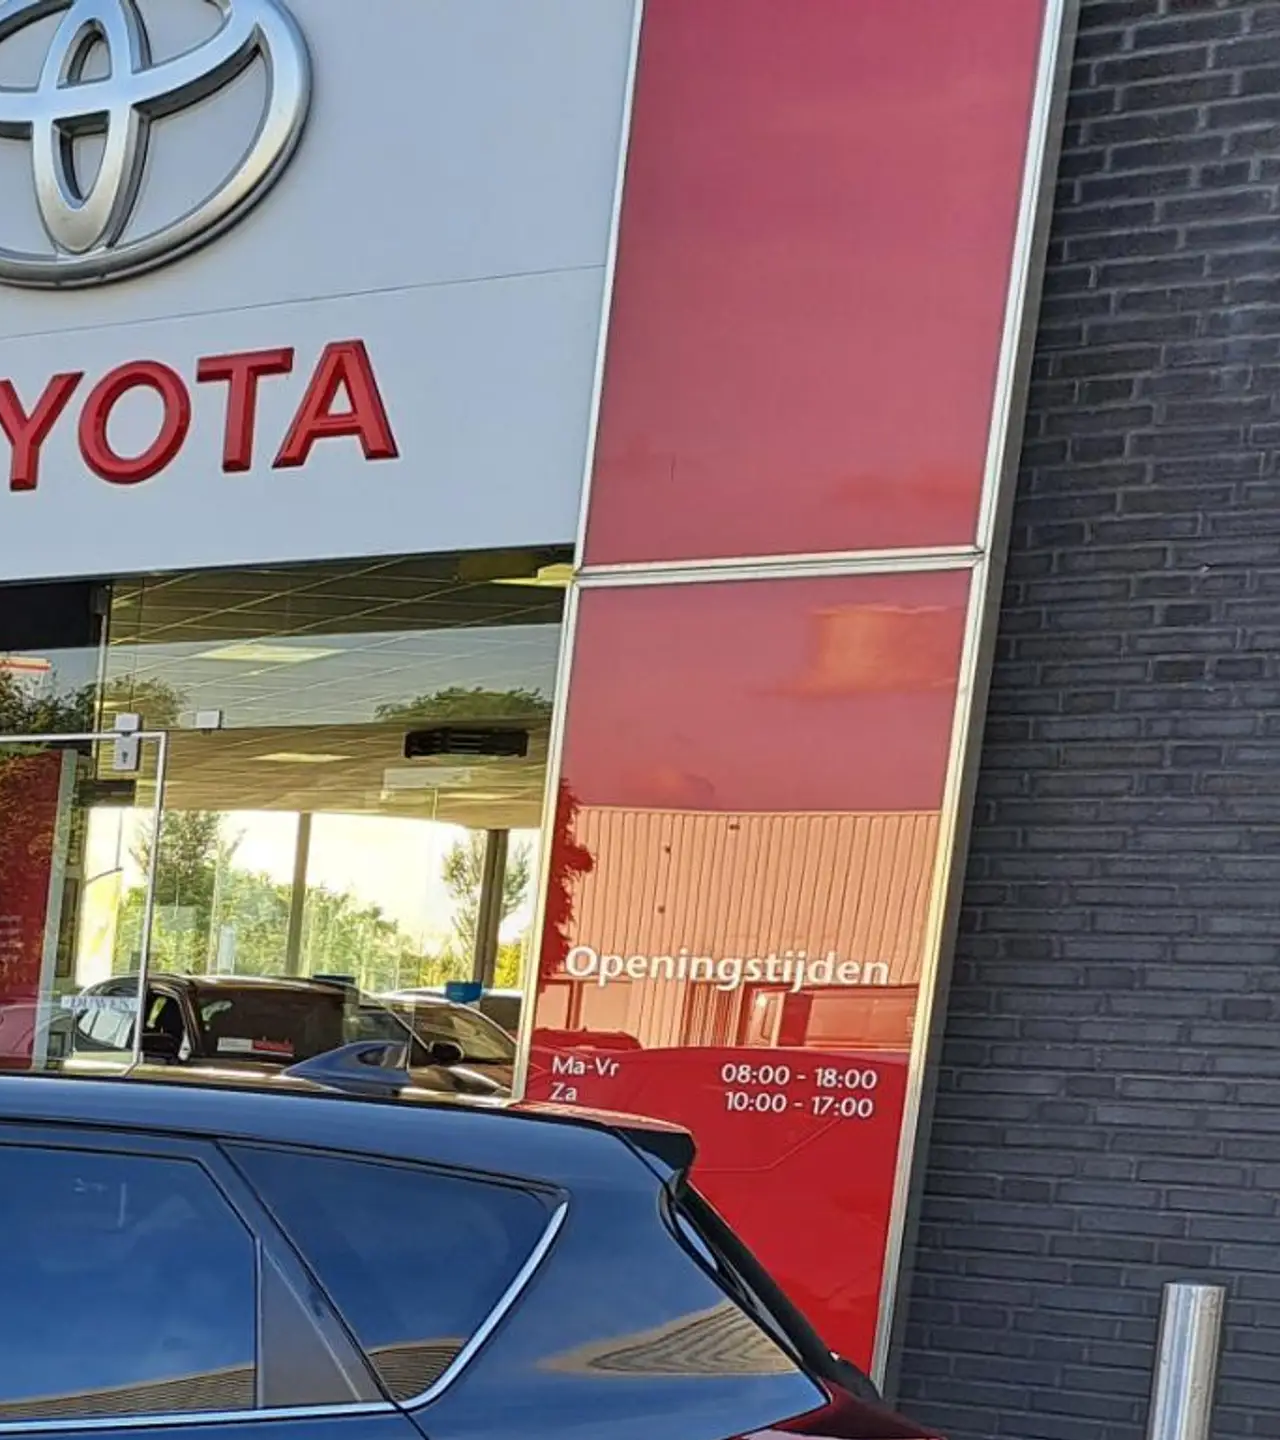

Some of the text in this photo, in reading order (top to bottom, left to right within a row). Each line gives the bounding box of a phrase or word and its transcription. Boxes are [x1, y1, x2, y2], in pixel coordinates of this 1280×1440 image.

[565, 946, 890, 993] Openingstijden
[551, 1057, 620, 1077] Ma-Vr
[721, 1063, 790, 1086] 08:00
[815, 1068, 878, 1090] 18:00
[550, 1083, 578, 1101] Za
[725, 1091, 787, 1113] 10:00
[812, 1096, 873, 1118] 17:00
